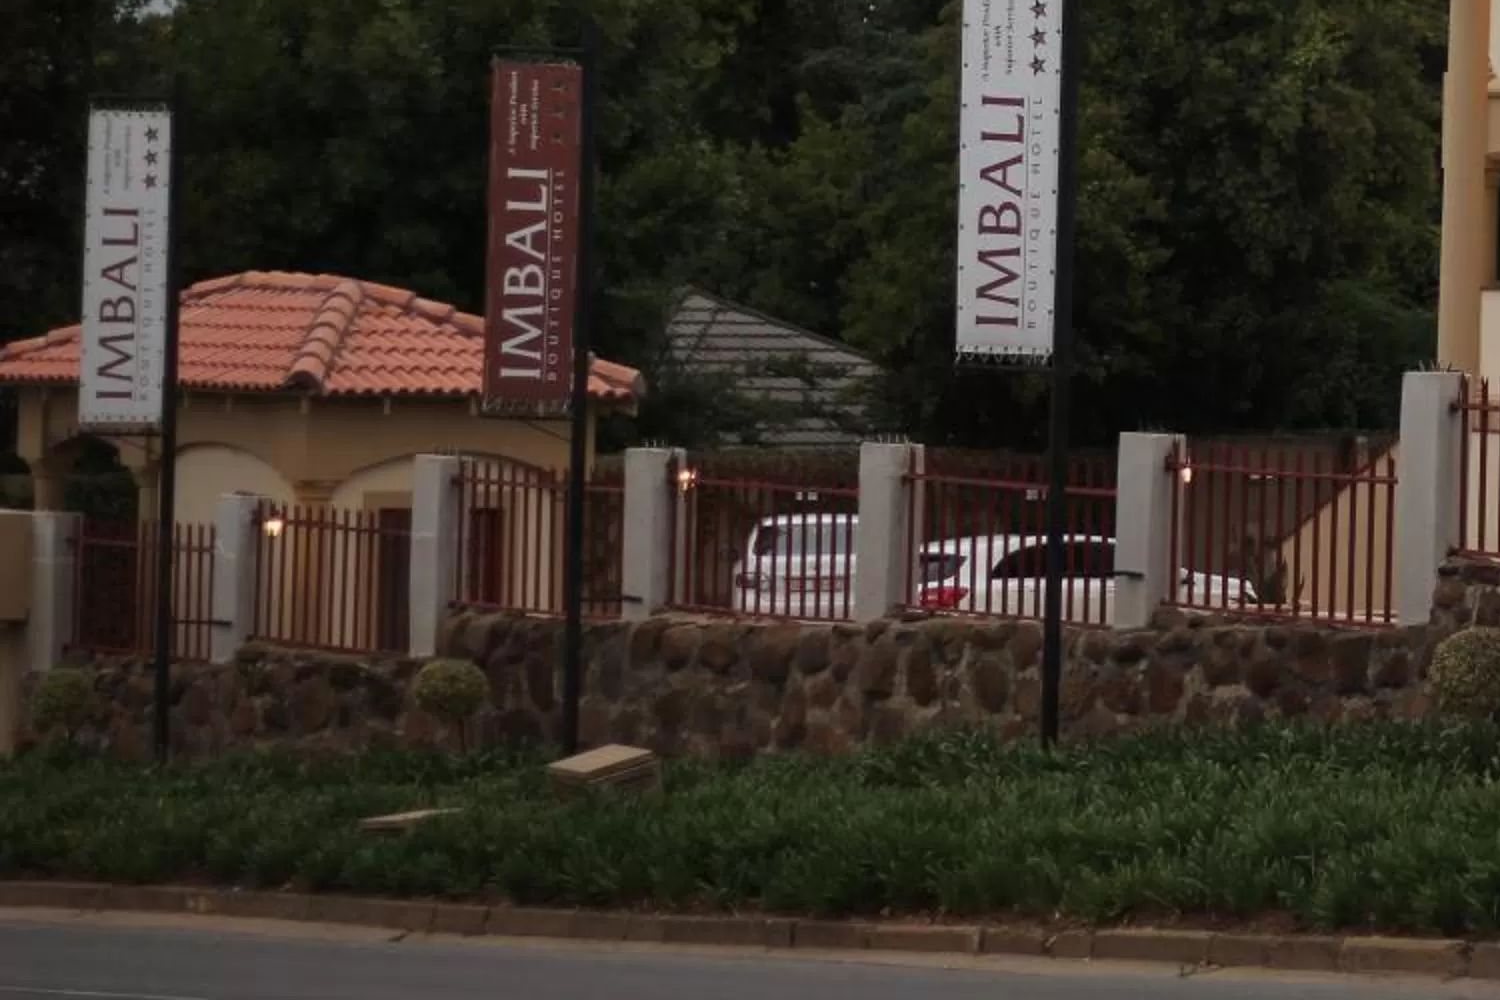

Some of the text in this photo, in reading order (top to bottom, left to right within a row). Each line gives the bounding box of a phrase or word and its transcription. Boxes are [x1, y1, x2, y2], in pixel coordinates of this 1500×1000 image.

[96, 208, 139, 400] IMBALI
[500, 167, 548, 380] IMBALI
[975, 95, 1025, 328] IMBALI
[549, 254, 563, 381] BOUTIQUE
